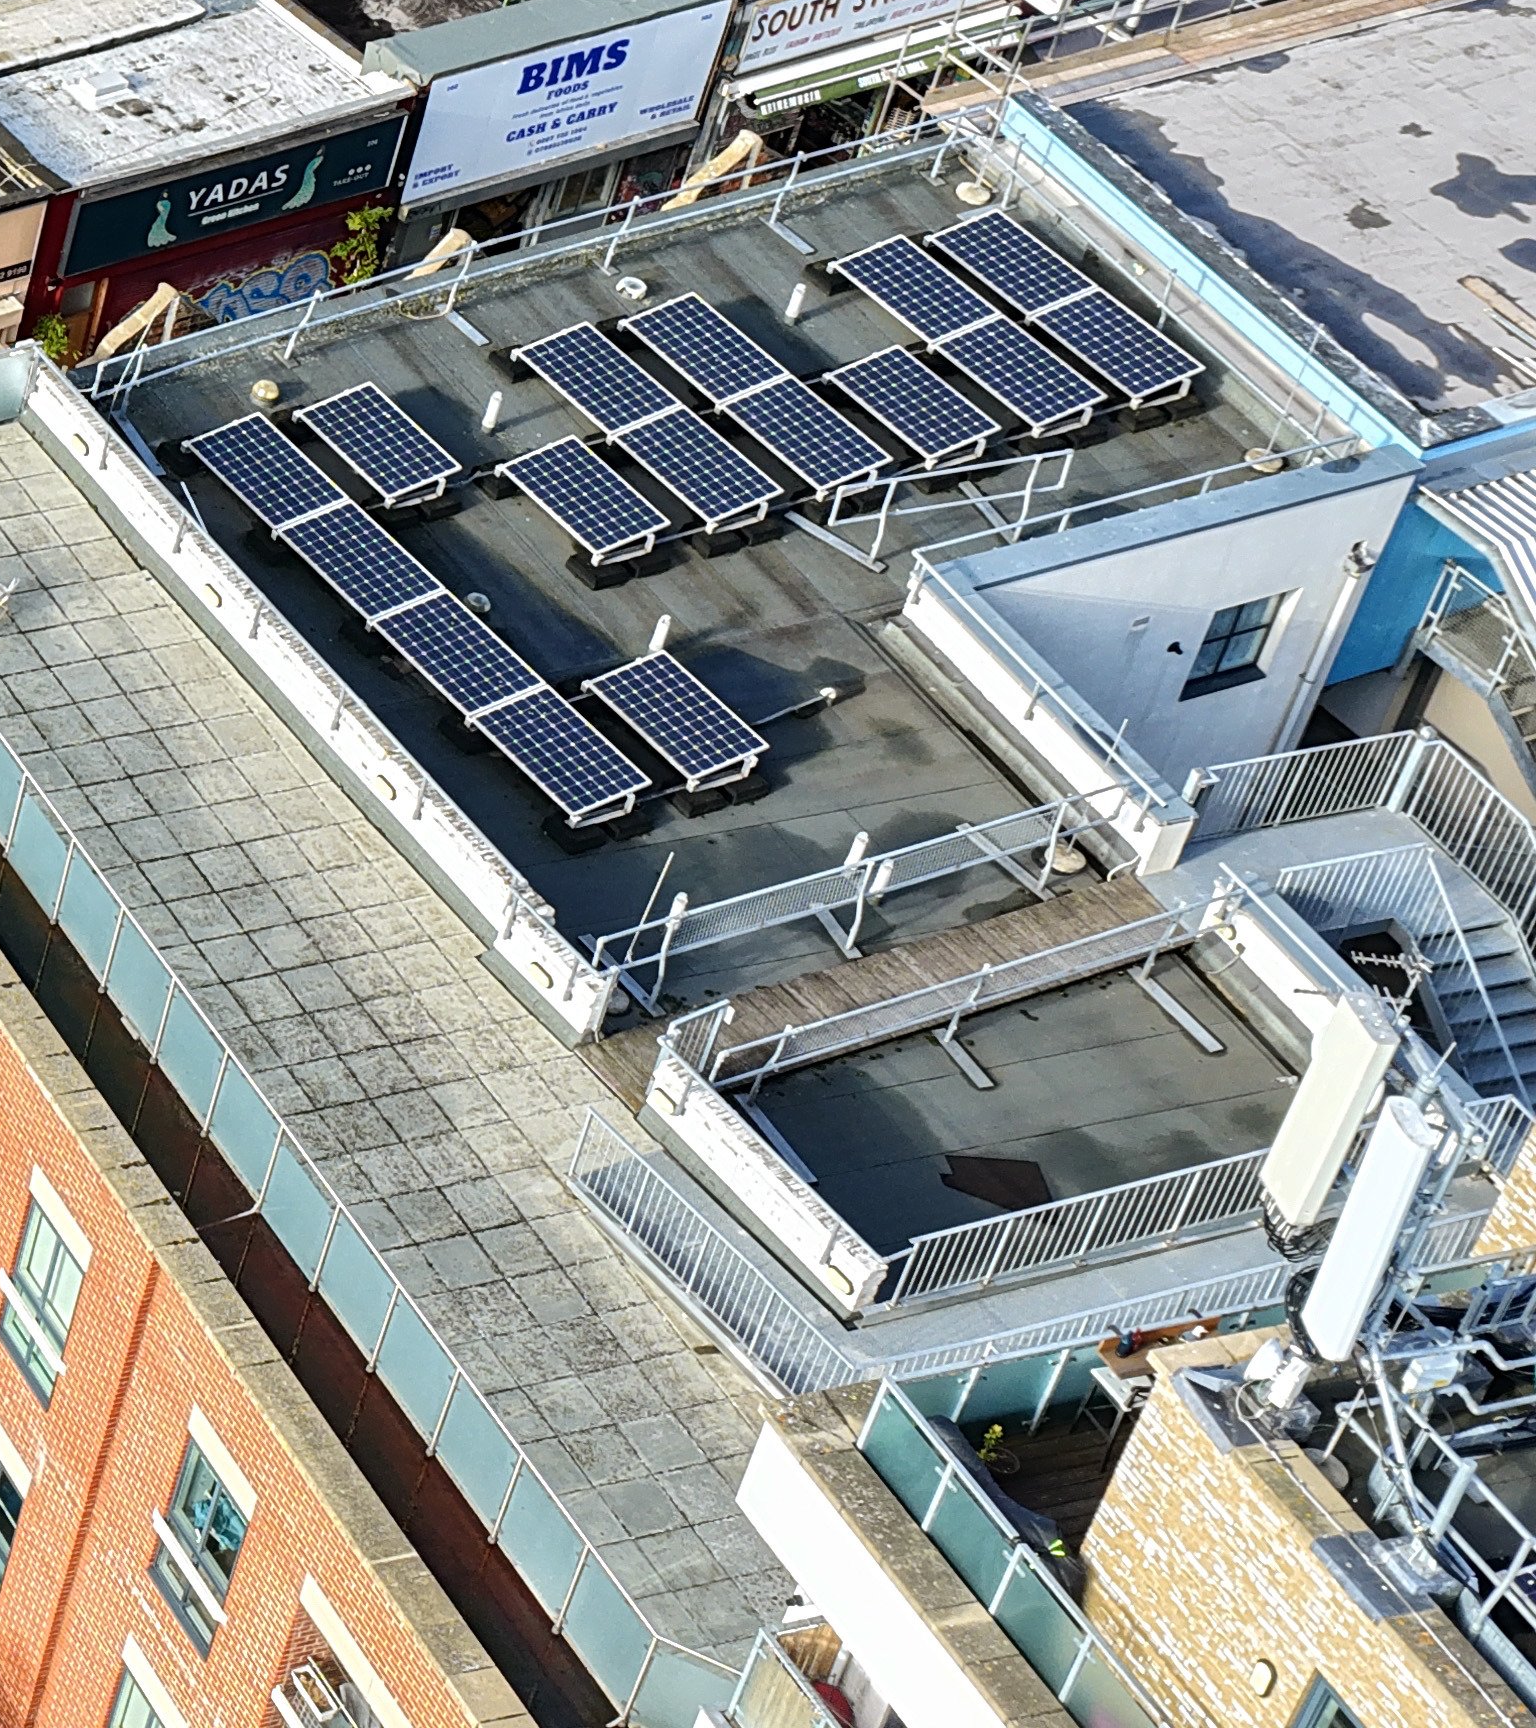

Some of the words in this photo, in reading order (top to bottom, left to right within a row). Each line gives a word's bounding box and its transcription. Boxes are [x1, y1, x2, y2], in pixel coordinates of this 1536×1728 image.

[517, 39, 630, 97] BIMS
[546, 81, 590, 100] FOODS
[506, 122, 547, 143] CASH
[551, 118, 561, 130] &
[566, 102, 618, 125] CARRY
[188, 164, 290, 212] YADAS
